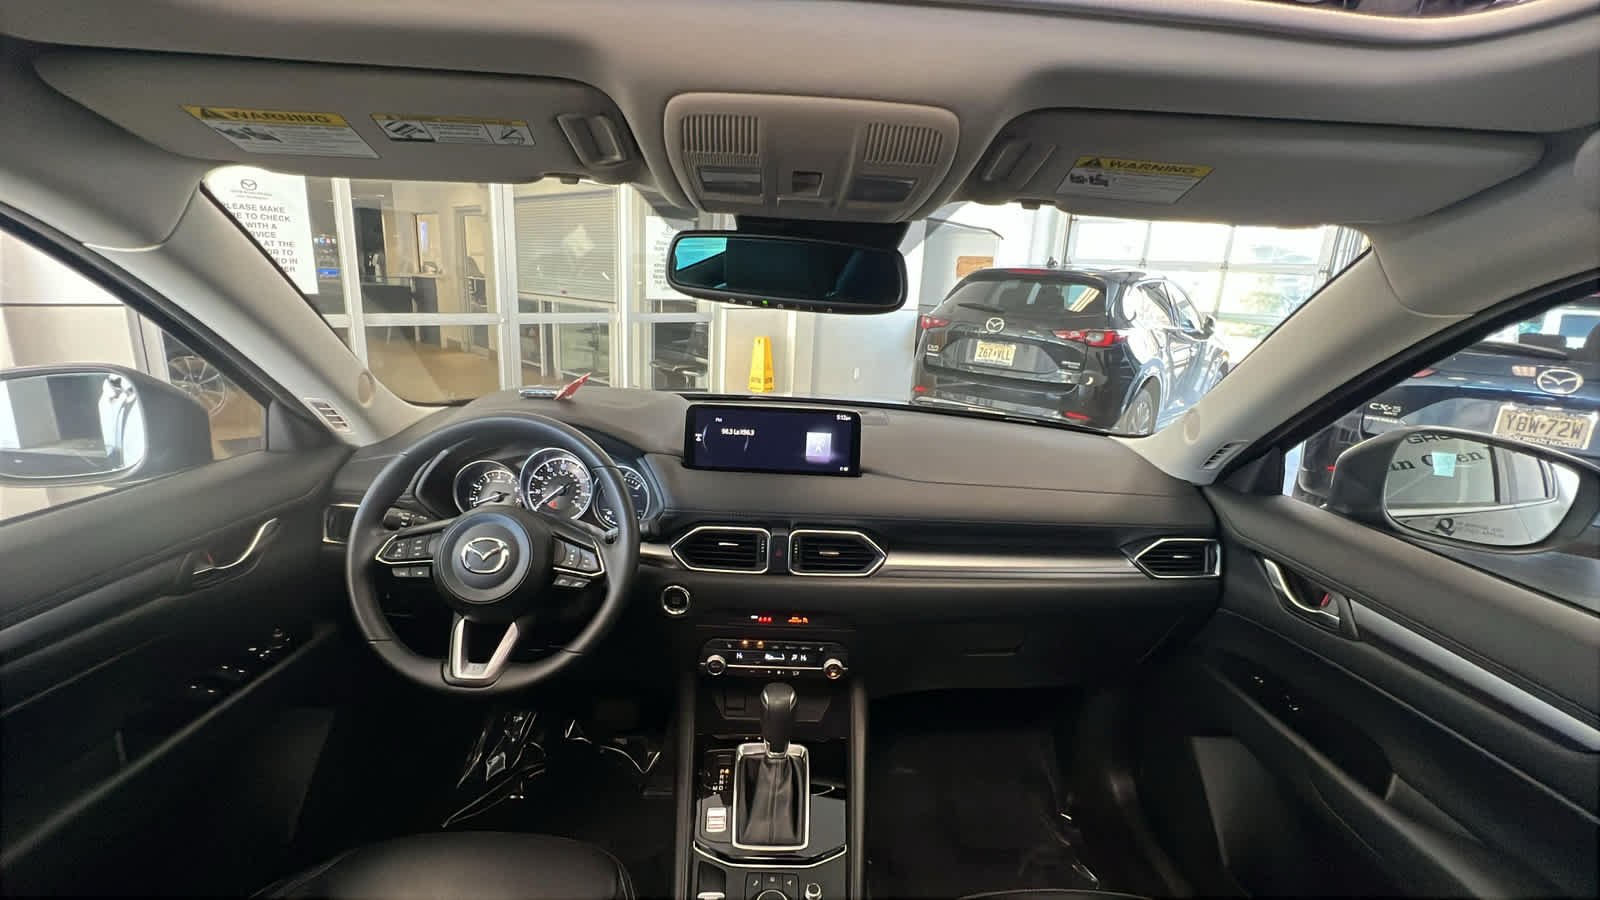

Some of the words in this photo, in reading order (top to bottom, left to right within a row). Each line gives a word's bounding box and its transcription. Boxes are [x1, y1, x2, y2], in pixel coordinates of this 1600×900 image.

[1109, 159, 1197, 174] WARNING
[259, 204, 285, 213] MAKE
[245, 212, 258, 220] TO
[260, 213, 290, 222] CHECK
[245, 221, 269, 229] WITH
